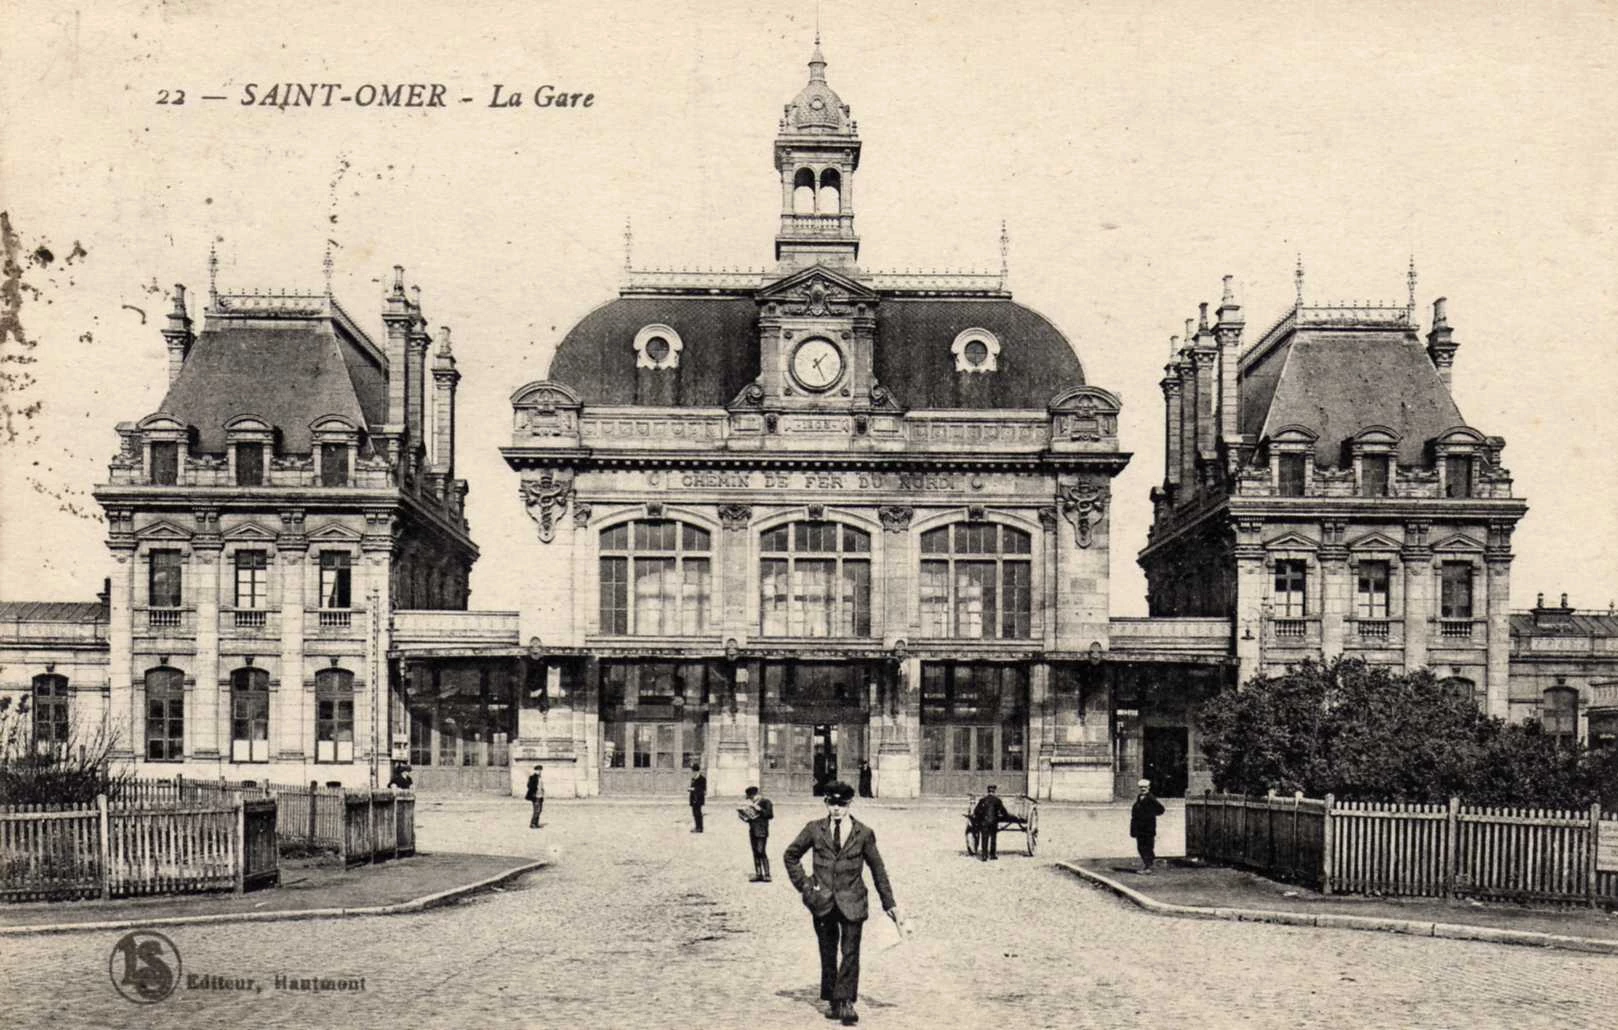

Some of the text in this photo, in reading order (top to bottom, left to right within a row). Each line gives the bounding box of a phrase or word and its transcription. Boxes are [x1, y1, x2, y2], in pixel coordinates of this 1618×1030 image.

[681, 474, 951, 490] CHEMIN DE FER DU NORD
